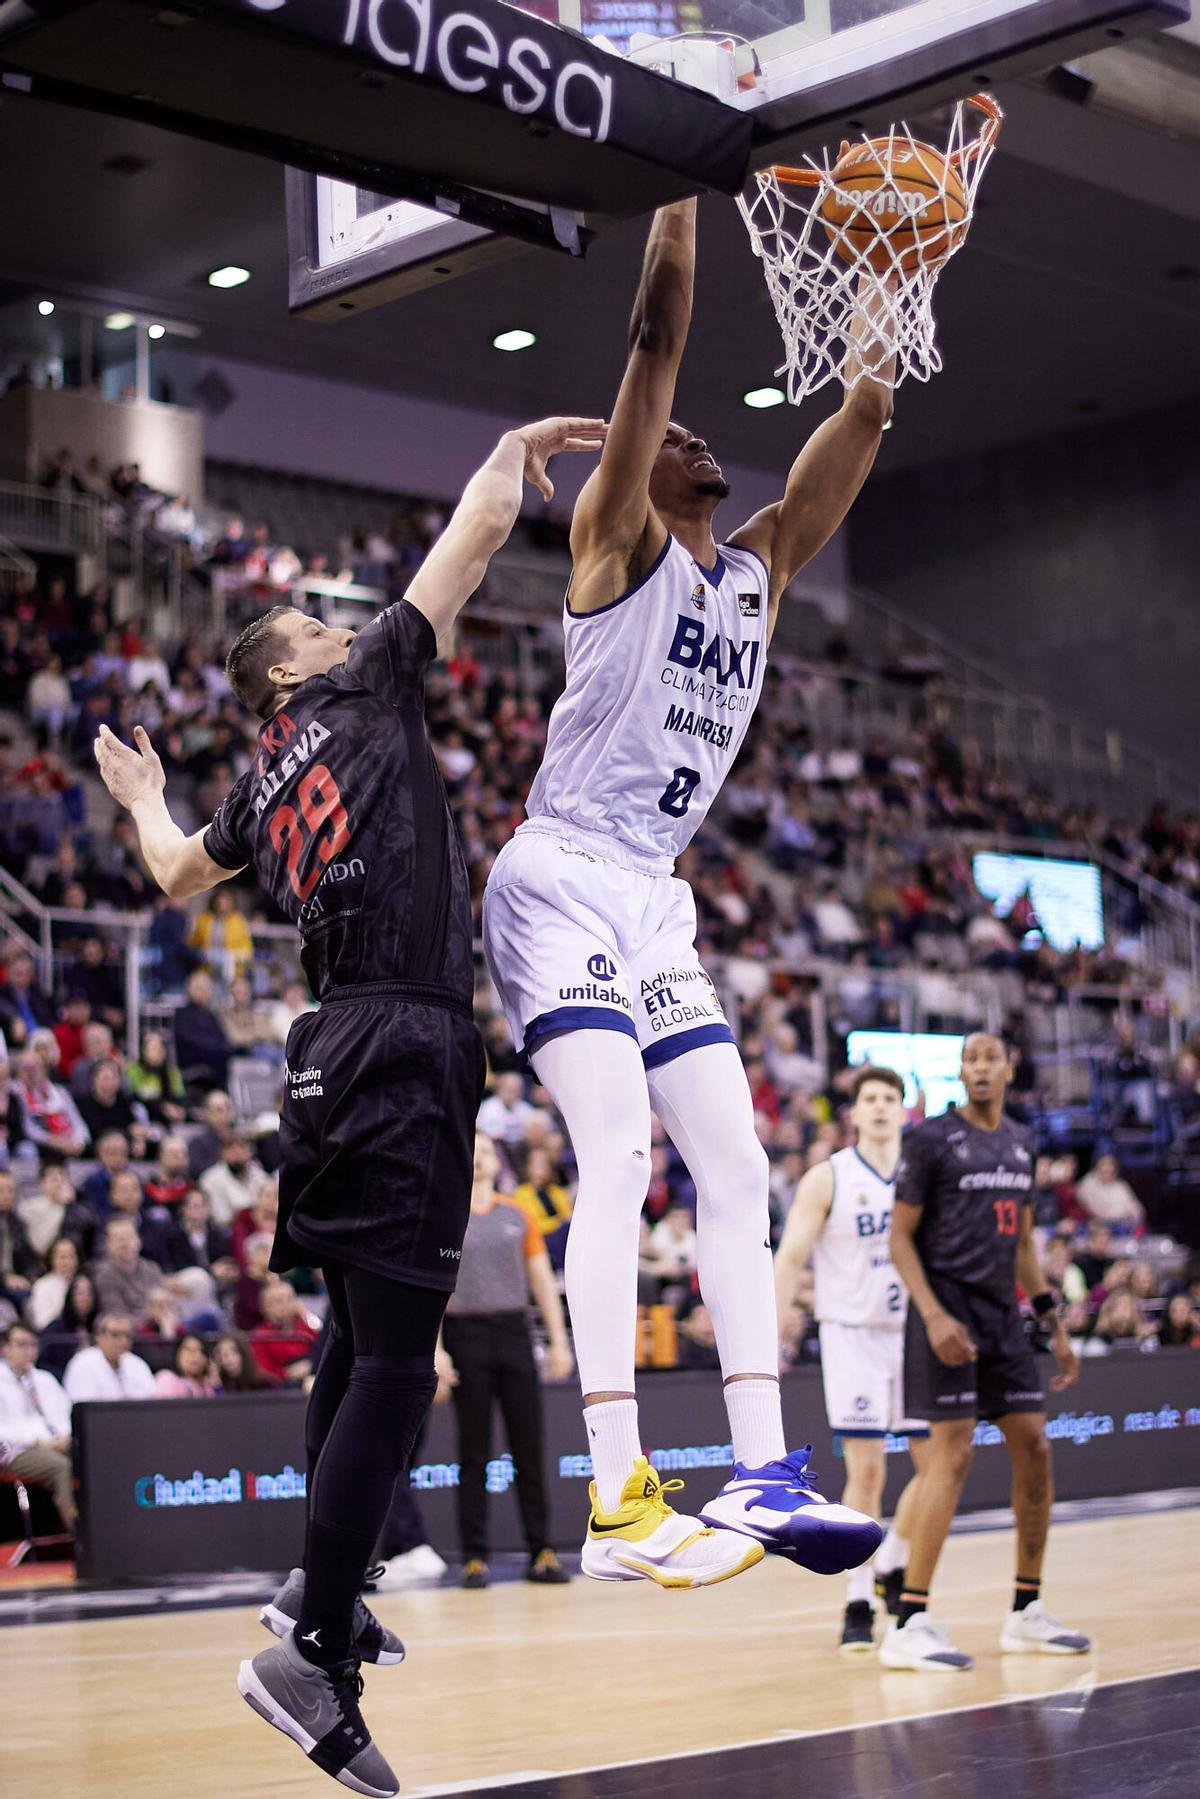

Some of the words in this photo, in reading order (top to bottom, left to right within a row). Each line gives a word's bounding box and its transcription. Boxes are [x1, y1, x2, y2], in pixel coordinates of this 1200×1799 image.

[667, 614, 760, 689] BAXI
[269, 764, 351, 903] 29
[559, 983, 632, 1011] unilabo
[644, 987, 681, 1016] ETL
[651, 1004, 714, 1032] GLOBAL
[993, 1199, 1018, 1235] 13
[134, 1468, 242, 1508] Ciudad
